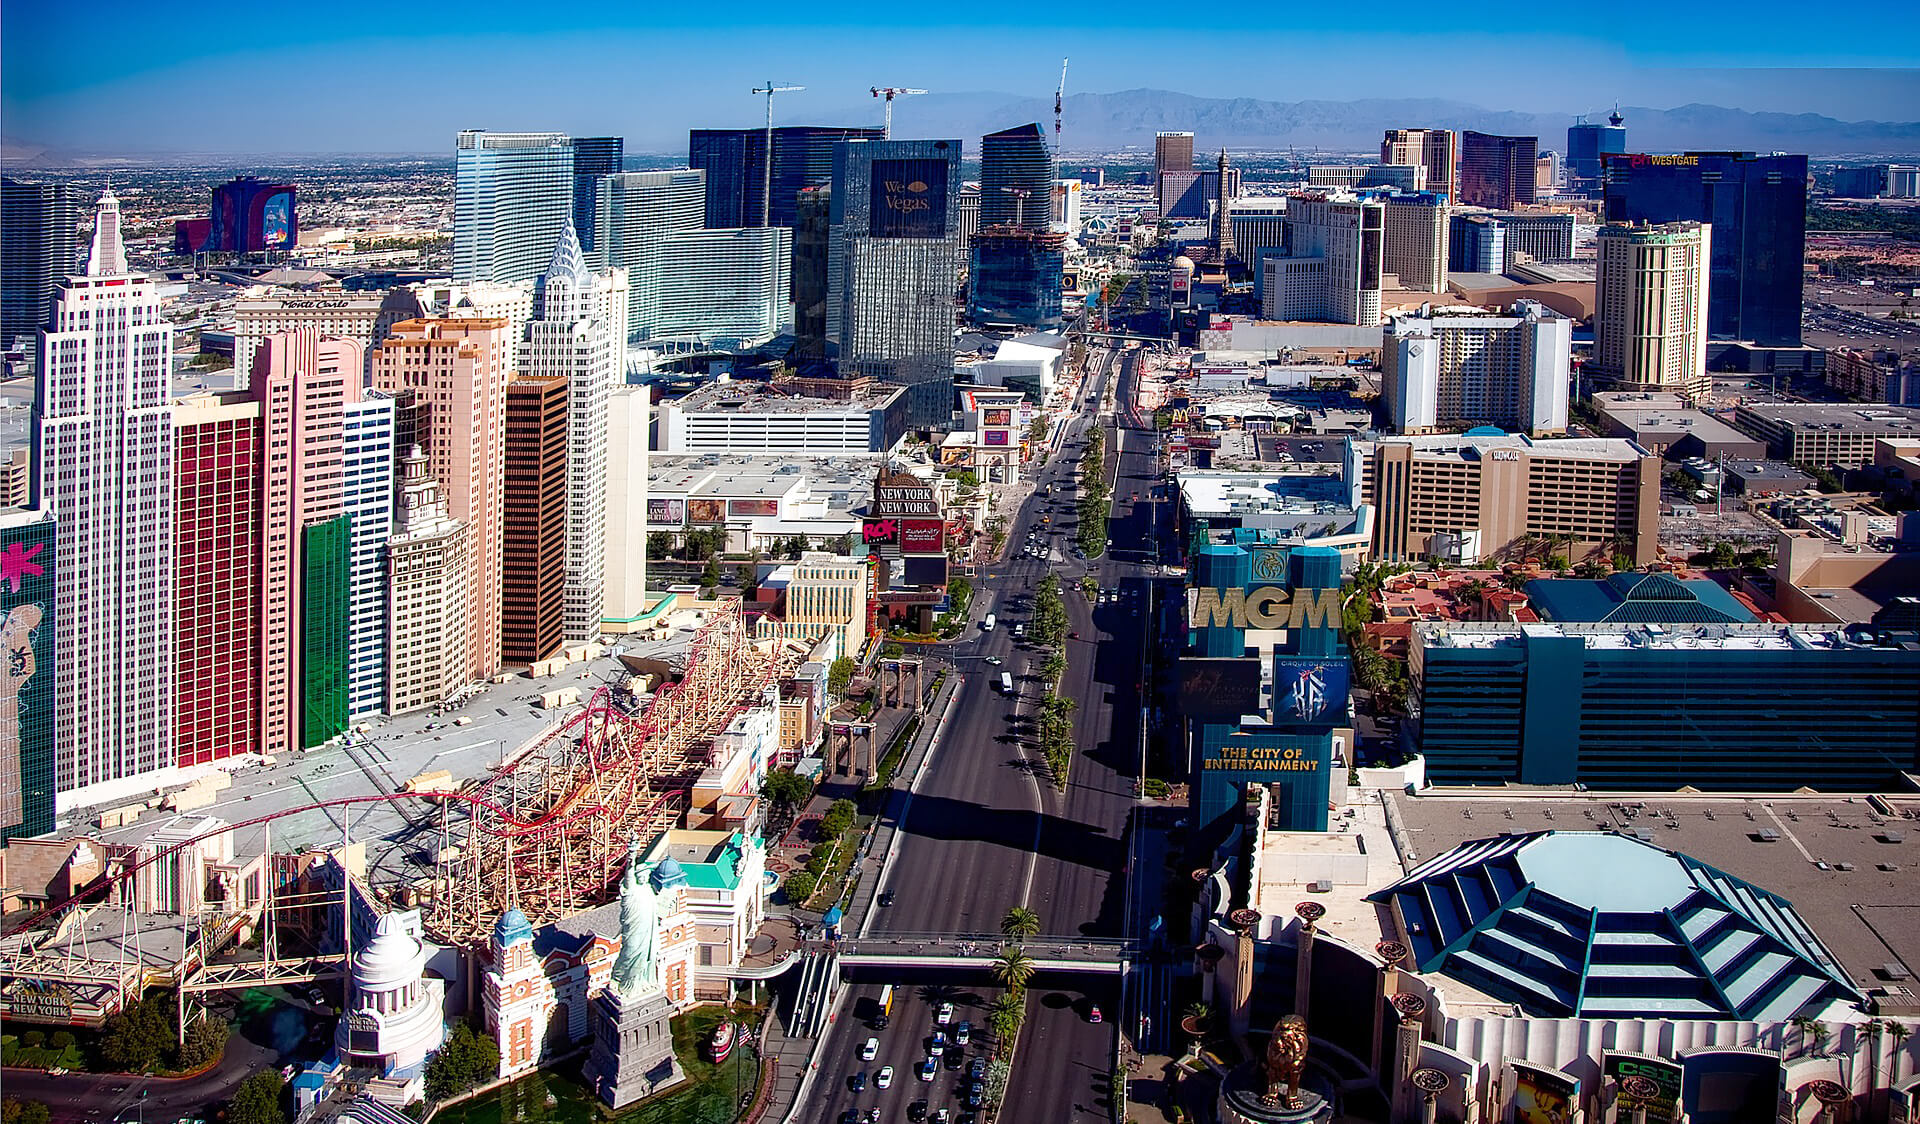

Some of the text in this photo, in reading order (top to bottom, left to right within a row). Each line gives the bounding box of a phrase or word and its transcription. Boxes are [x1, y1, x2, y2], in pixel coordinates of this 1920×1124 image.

[1652, 156, 1698, 166] WESTGATE
[884, 181, 905, 193] We
[886, 195, 930, 213] Vegas.
[281, 300, 349, 309] Monte Carlo
[880, 489, 931, 500] NEW YORK
[880, 502, 931, 513] NEW YORK
[1192, 586, 1342, 630] MGM
[1222, 748, 1303, 759] THE CITY OF
[1204, 759, 1319, 771] ENTERTAINMENT
[13, 994, 67, 1006] NEW YORK
[13, 1004, 68, 1016] NEW YORK
